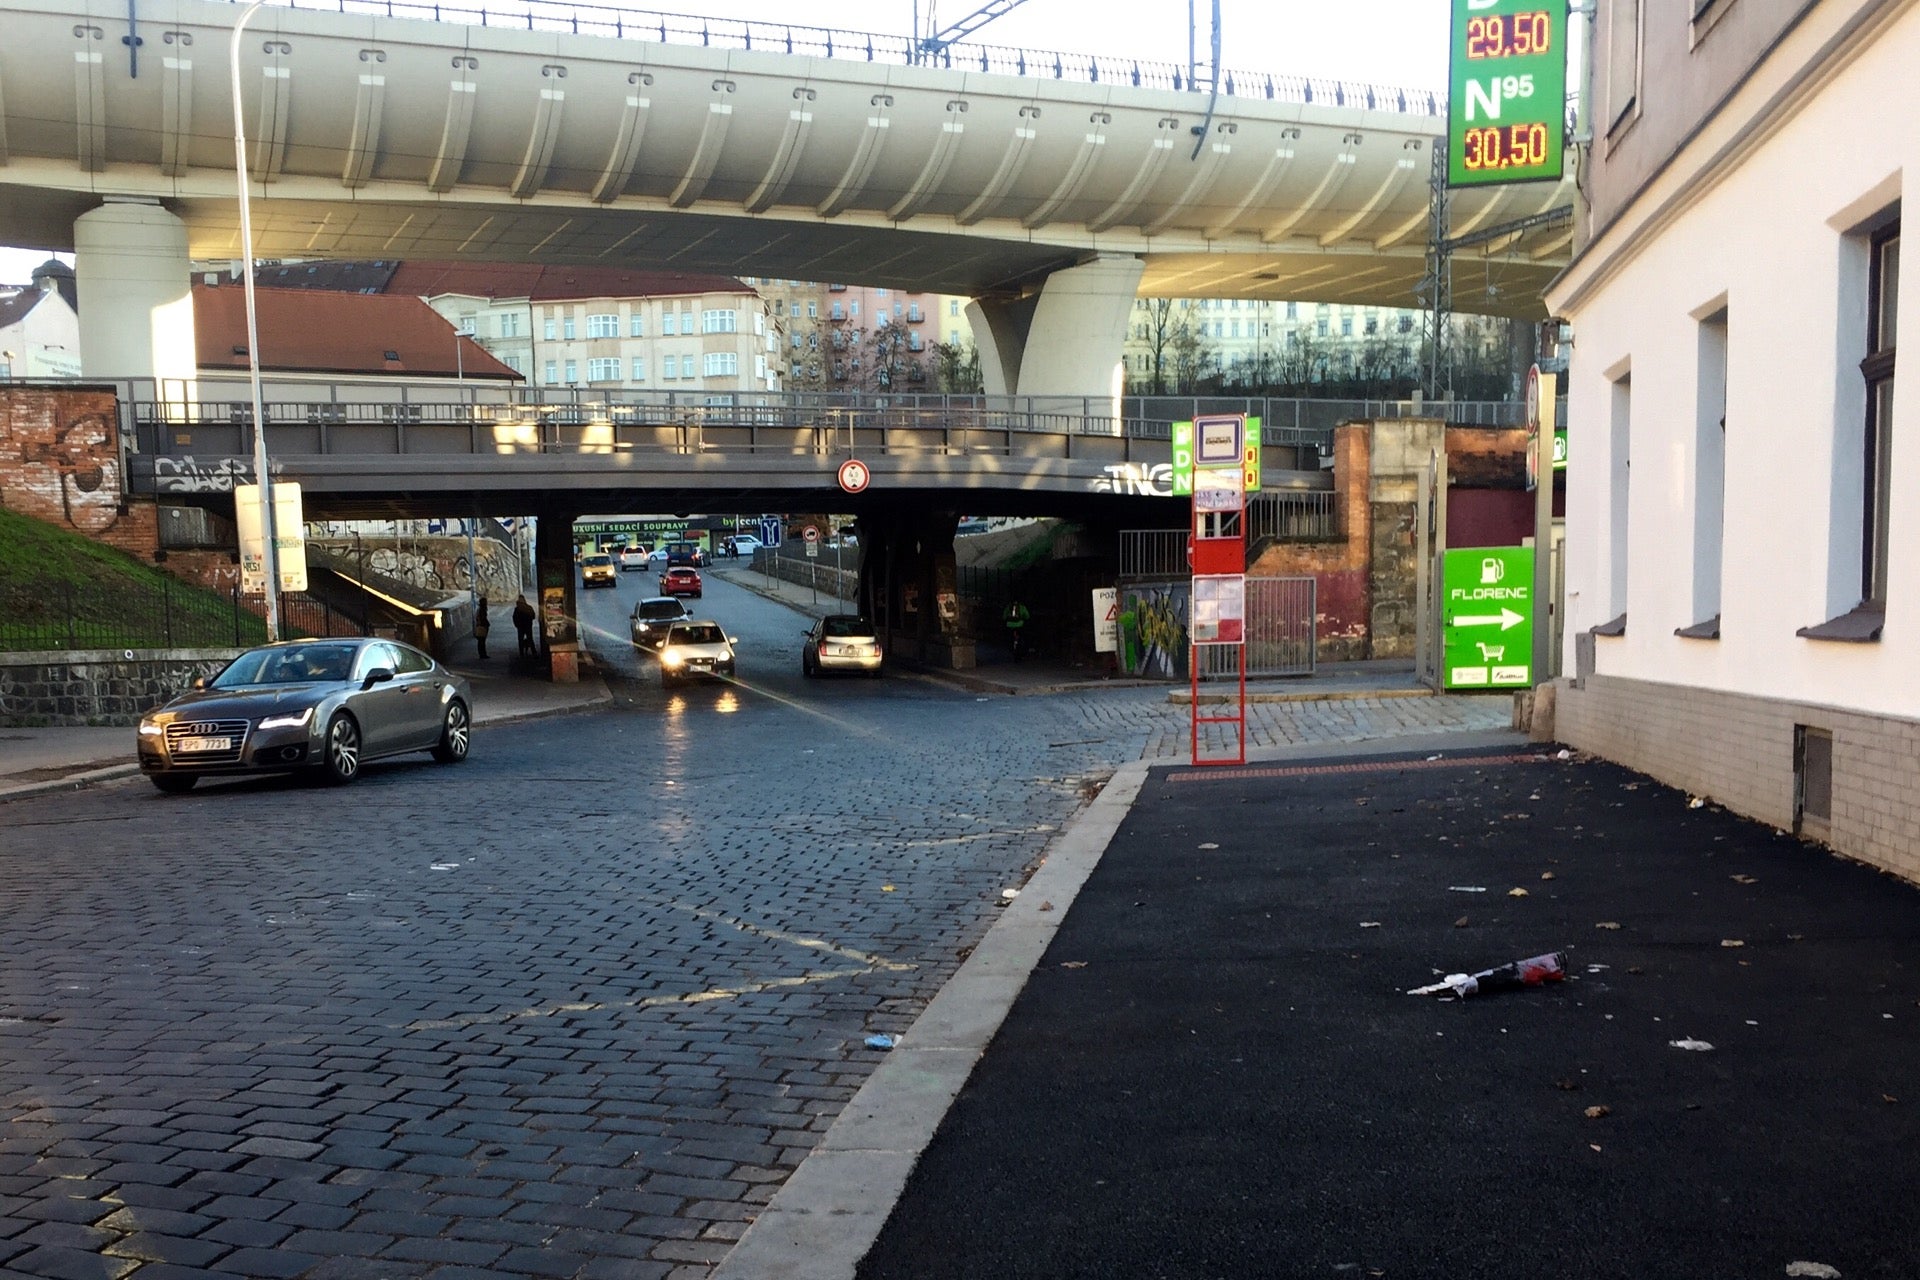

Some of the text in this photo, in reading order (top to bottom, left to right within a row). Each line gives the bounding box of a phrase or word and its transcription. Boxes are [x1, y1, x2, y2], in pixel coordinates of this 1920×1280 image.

[1467, 12, 1549, 58] 29,50
[1465, 122, 1547, 169] 30,50
[573, 521, 690, 532] UXUSNÍ SEDACÍ SOUPRAVY
[1100, 591, 1116, 600] POZ
[1451, 587, 1528, 600] FLORENC
